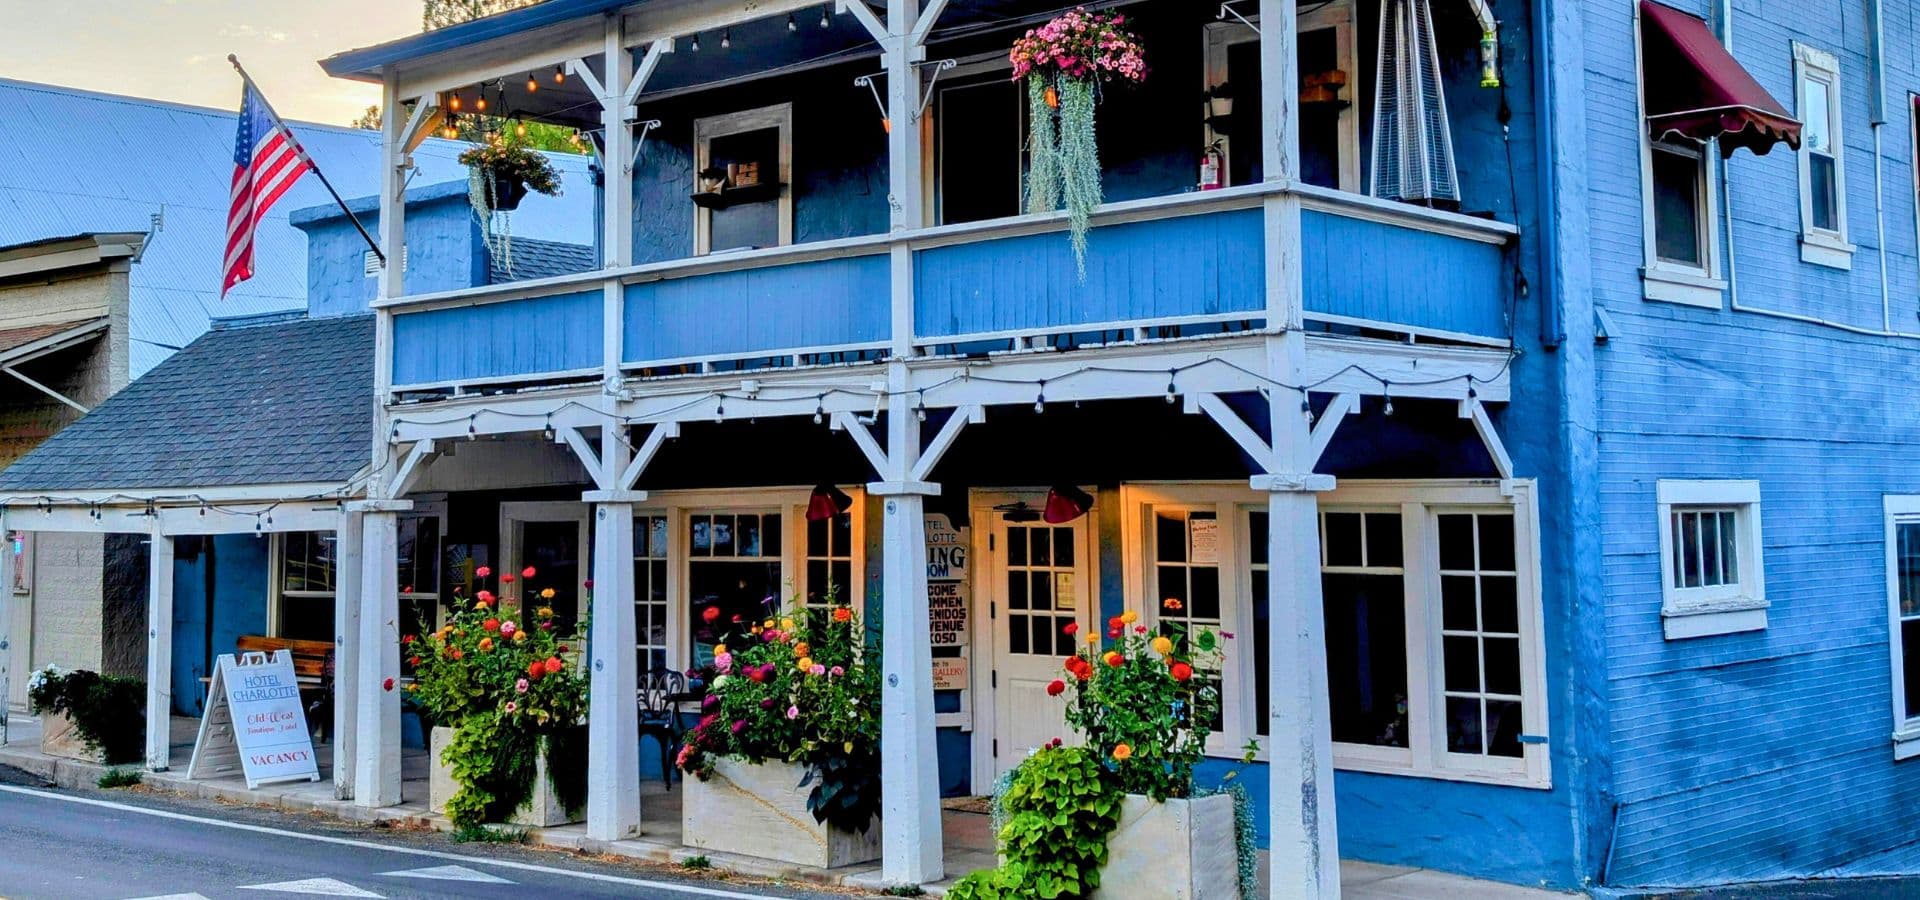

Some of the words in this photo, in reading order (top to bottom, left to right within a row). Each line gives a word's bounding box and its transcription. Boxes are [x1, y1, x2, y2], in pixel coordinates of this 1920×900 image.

[928, 520, 944, 530] TEL
[927, 533, 957, 543] LOTTE
[929, 547, 965, 569] ING
[928, 585, 957, 596] COME
[929, 608, 966, 620] ENIDOS
[930, 620, 964, 632] VENUE
[244, 674, 281, 688] HOTEL
[233, 685, 298, 701] CHARLOTTE
[250, 751, 309, 766] VACANCY
